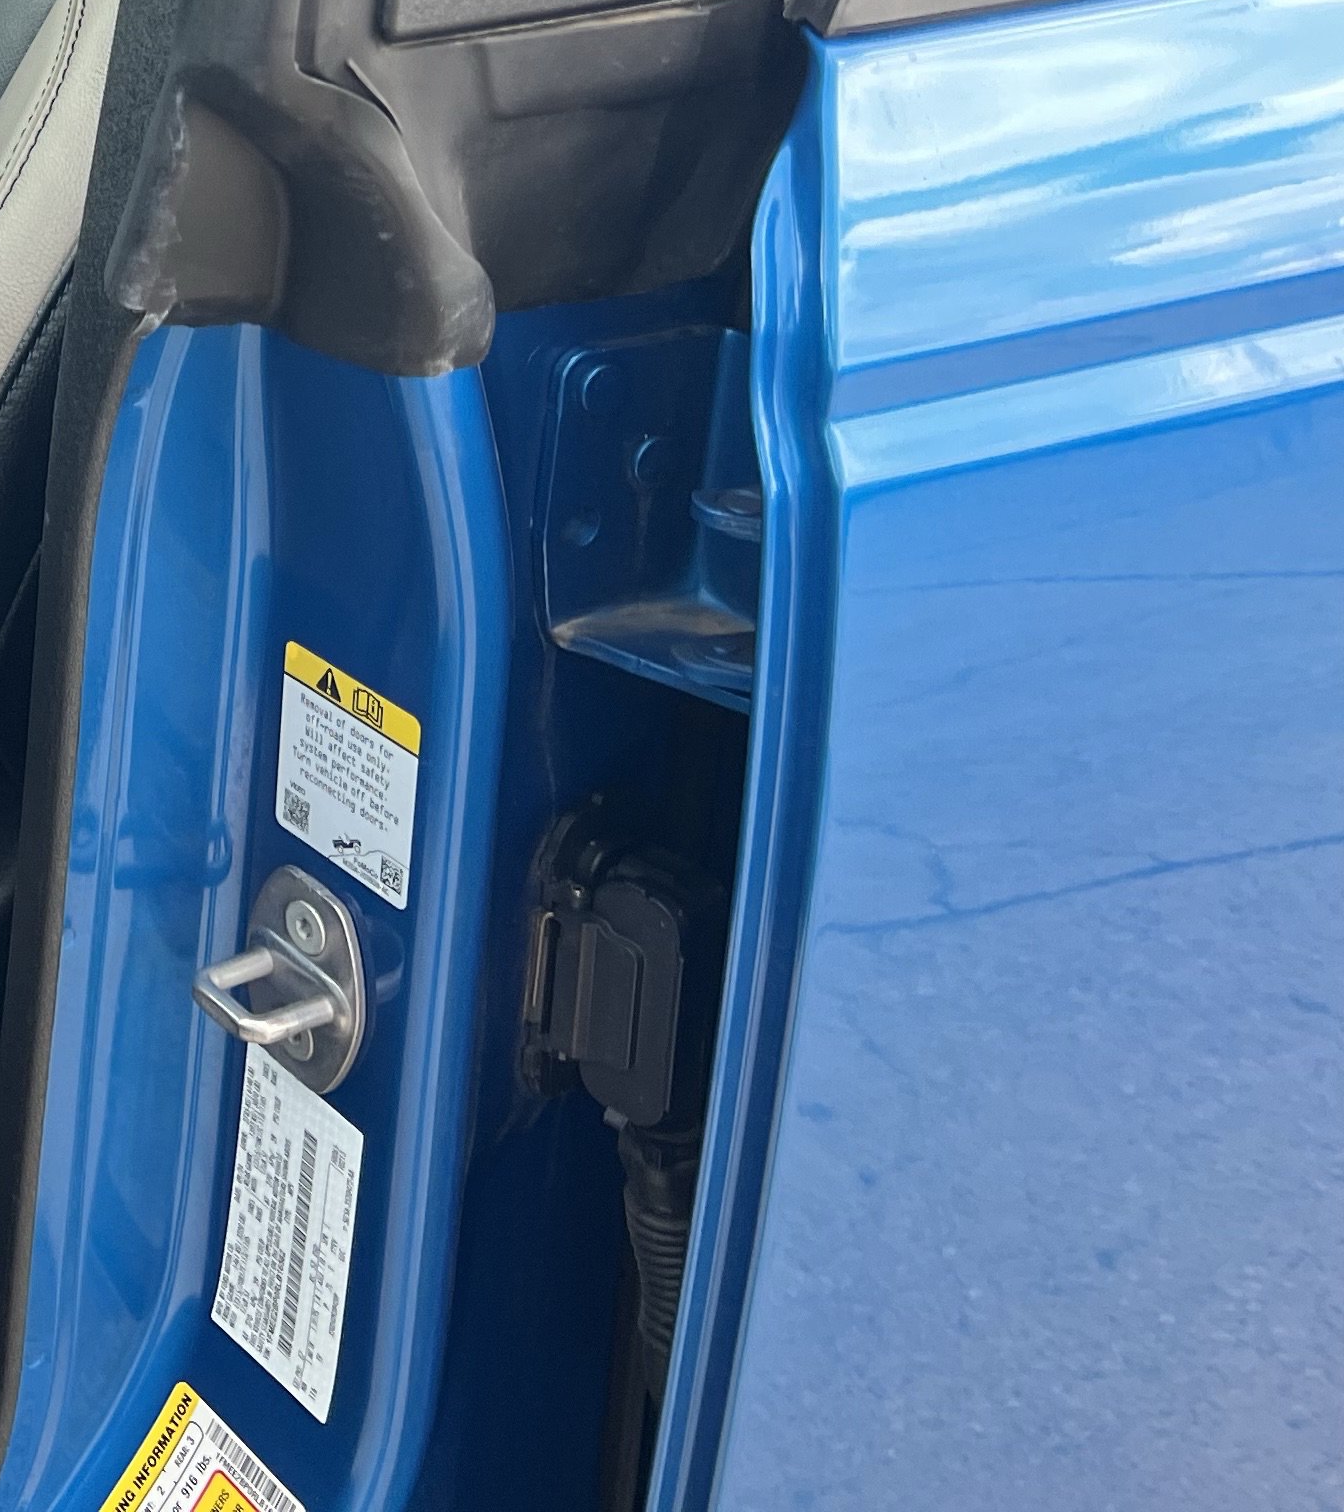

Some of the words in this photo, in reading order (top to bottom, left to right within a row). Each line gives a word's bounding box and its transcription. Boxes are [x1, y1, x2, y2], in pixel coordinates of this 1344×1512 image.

[300, 692, 333, 723] Removal
[336, 718, 346, 728] of
[350, 726, 375, 750] doors
[379, 744, 394, 761] for
[305, 713, 344, 745] off-road
[347, 743, 363, 756] use
[366, 751, 390, 774] only.
[293, 744, 312, 767] Turn
[315, 762, 348, 792] vehicle
[351, 786, 366, 802] off
[369, 797, 400, 825] before
[299, 738, 328, 763] system
[331, 758, 388, 802] performance.
[305, 726, 324, 746] Will
[328, 742, 356, 767] affect
[361, 763, 390, 791] safety
[299, 767, 356, 814] reconnecting
[133, 1392, 193, 1490] INFORMATION
[187, 1435, 195, 1445] 3
[195, 1455, 212, 1475] lbs.
[157, 1485, 166, 1496] 2
